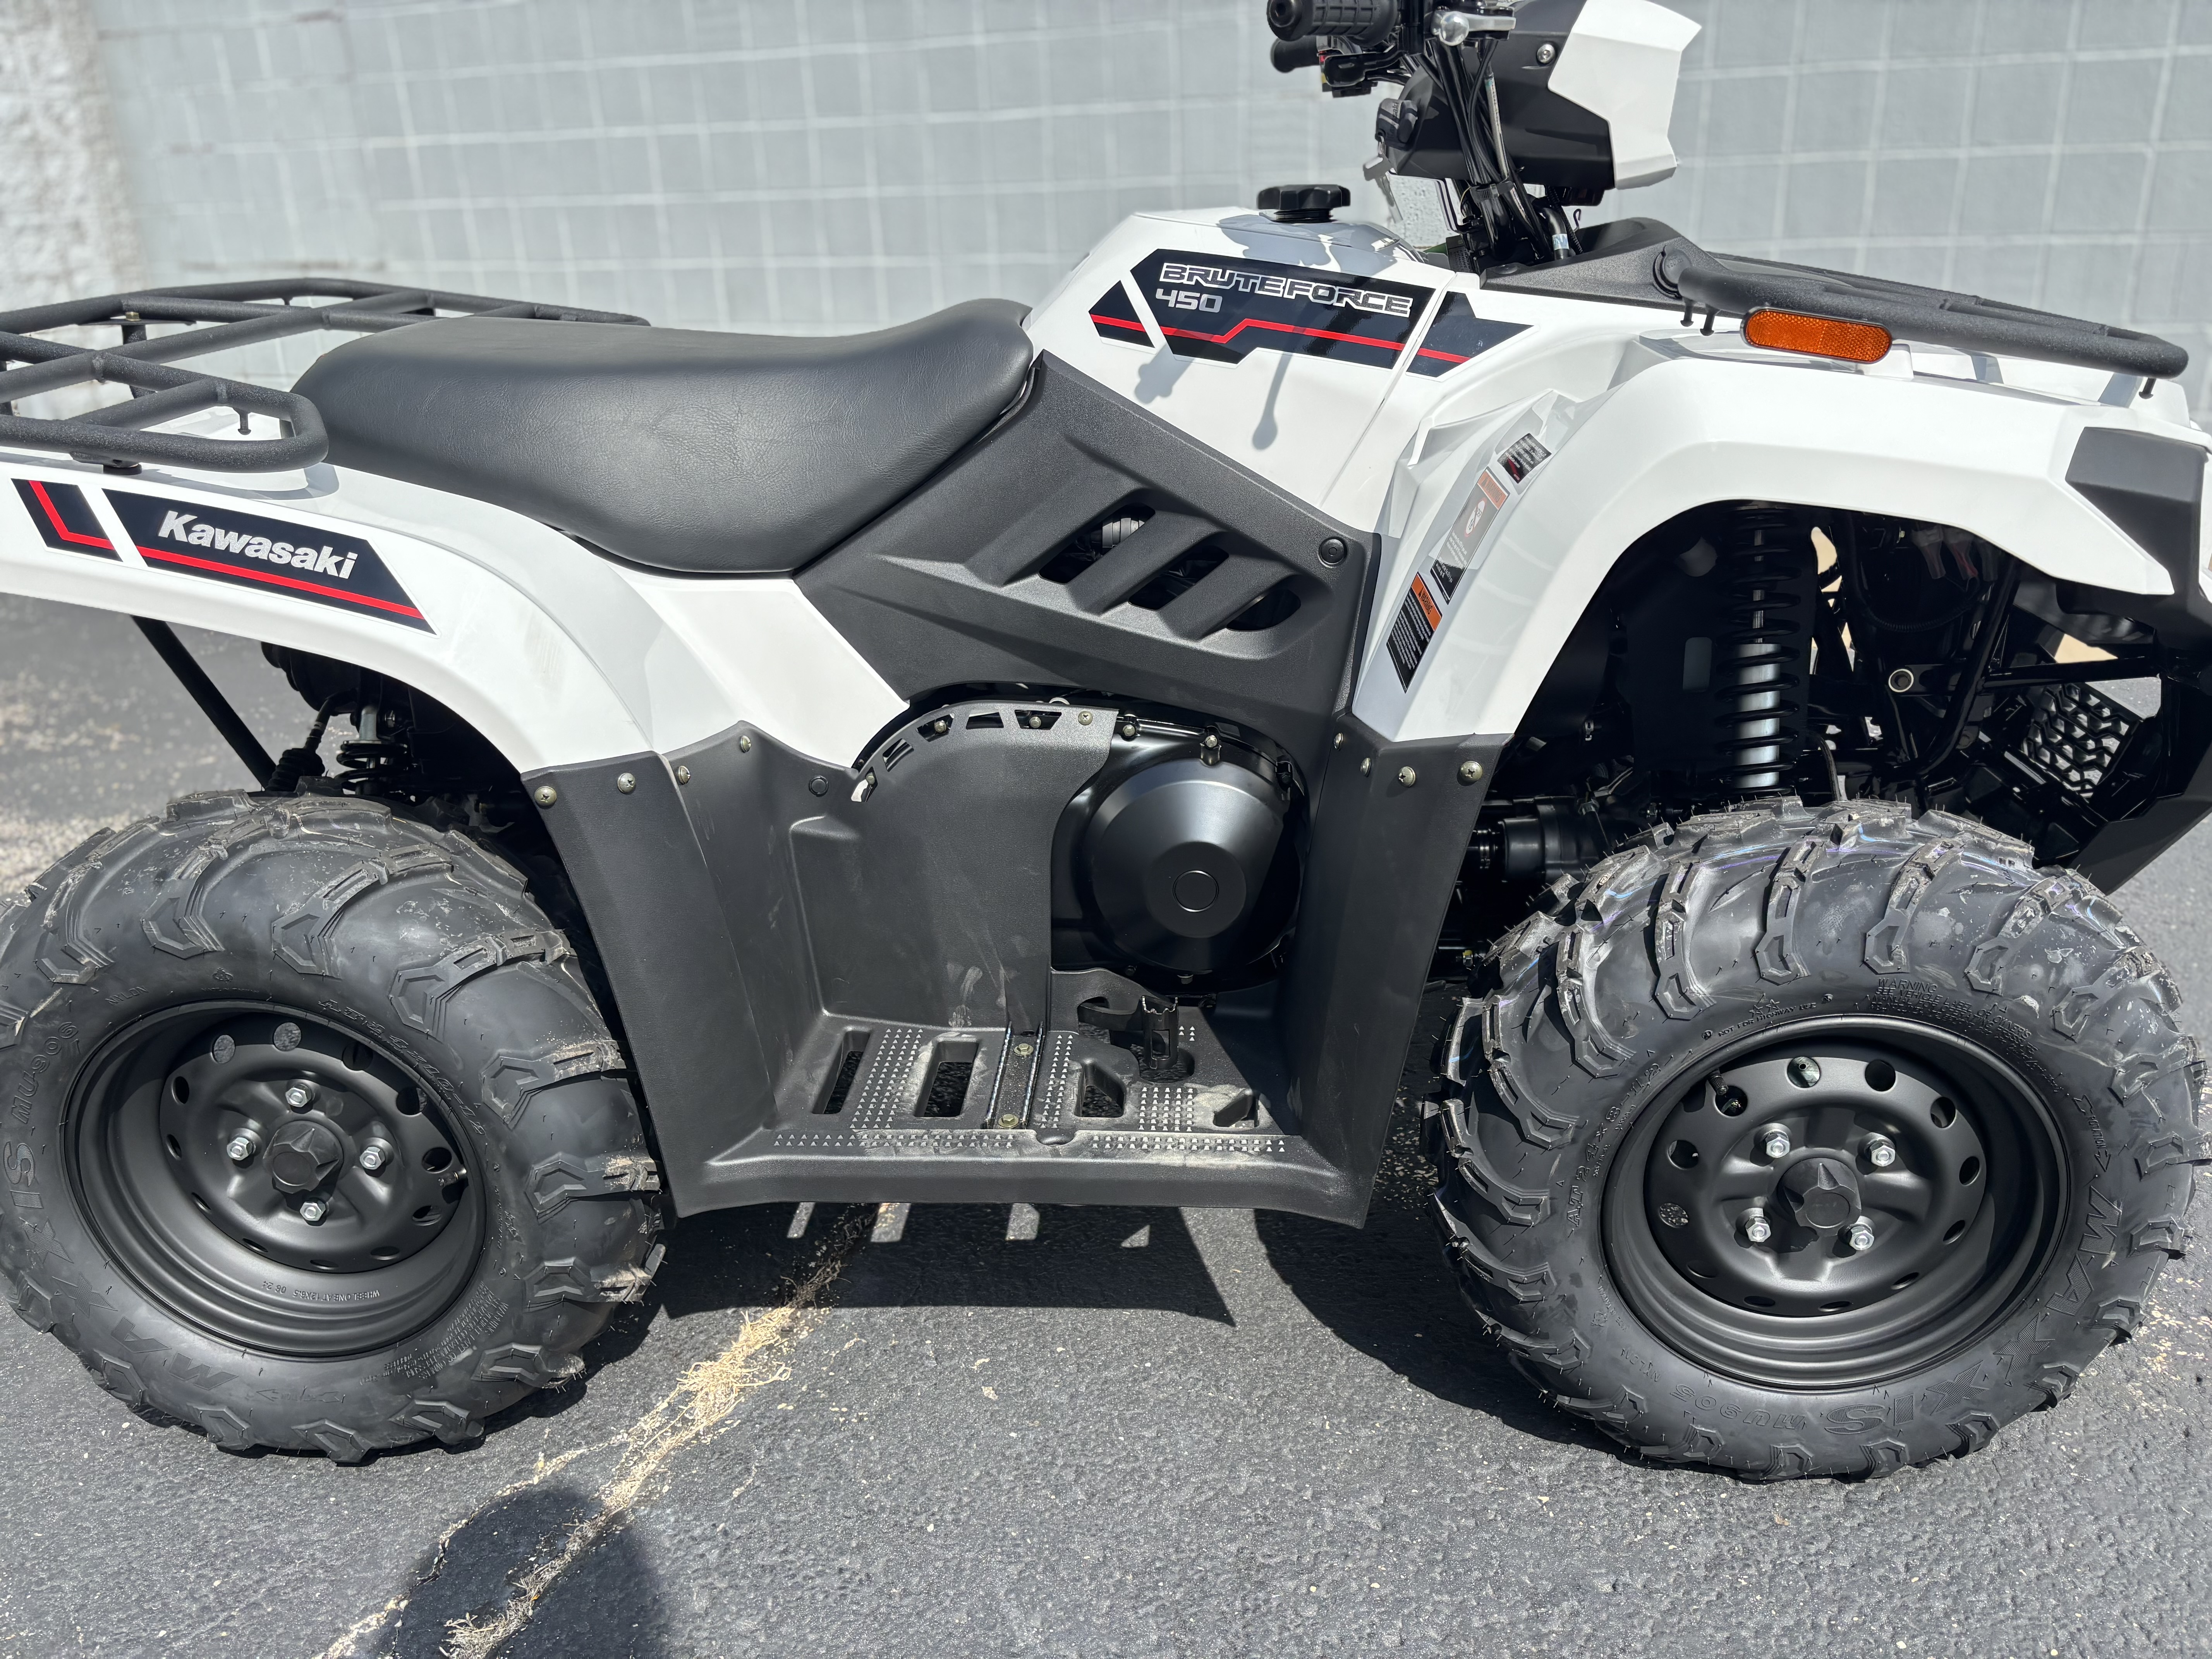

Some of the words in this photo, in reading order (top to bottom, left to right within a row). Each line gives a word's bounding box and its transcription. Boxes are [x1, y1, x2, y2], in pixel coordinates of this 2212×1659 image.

[1156, 289, 1223, 313] 450
[158, 510, 359, 580] Kawasaki
[105, 986, 149, 1005] NYLON
[1876, 987, 1896, 995] SEE
[1900, 989, 1943, 1002] VEHICLE
[1879, 977, 1938, 993] WARNING
[1718, 1025, 1734, 1037] NOT
[1737, 1018, 1754, 1029] FOR
[1757, 1006, 1796, 1022] HIGHWAY
[1799, 1002, 1817, 1011] USE
[11, 1022, 79, 1124] MU906
[353, 1290, 380, 1301] WHEEL
[1620, 1348, 1661, 1382] NYLON
[1670, 1384, 1806, 1430] MU905
